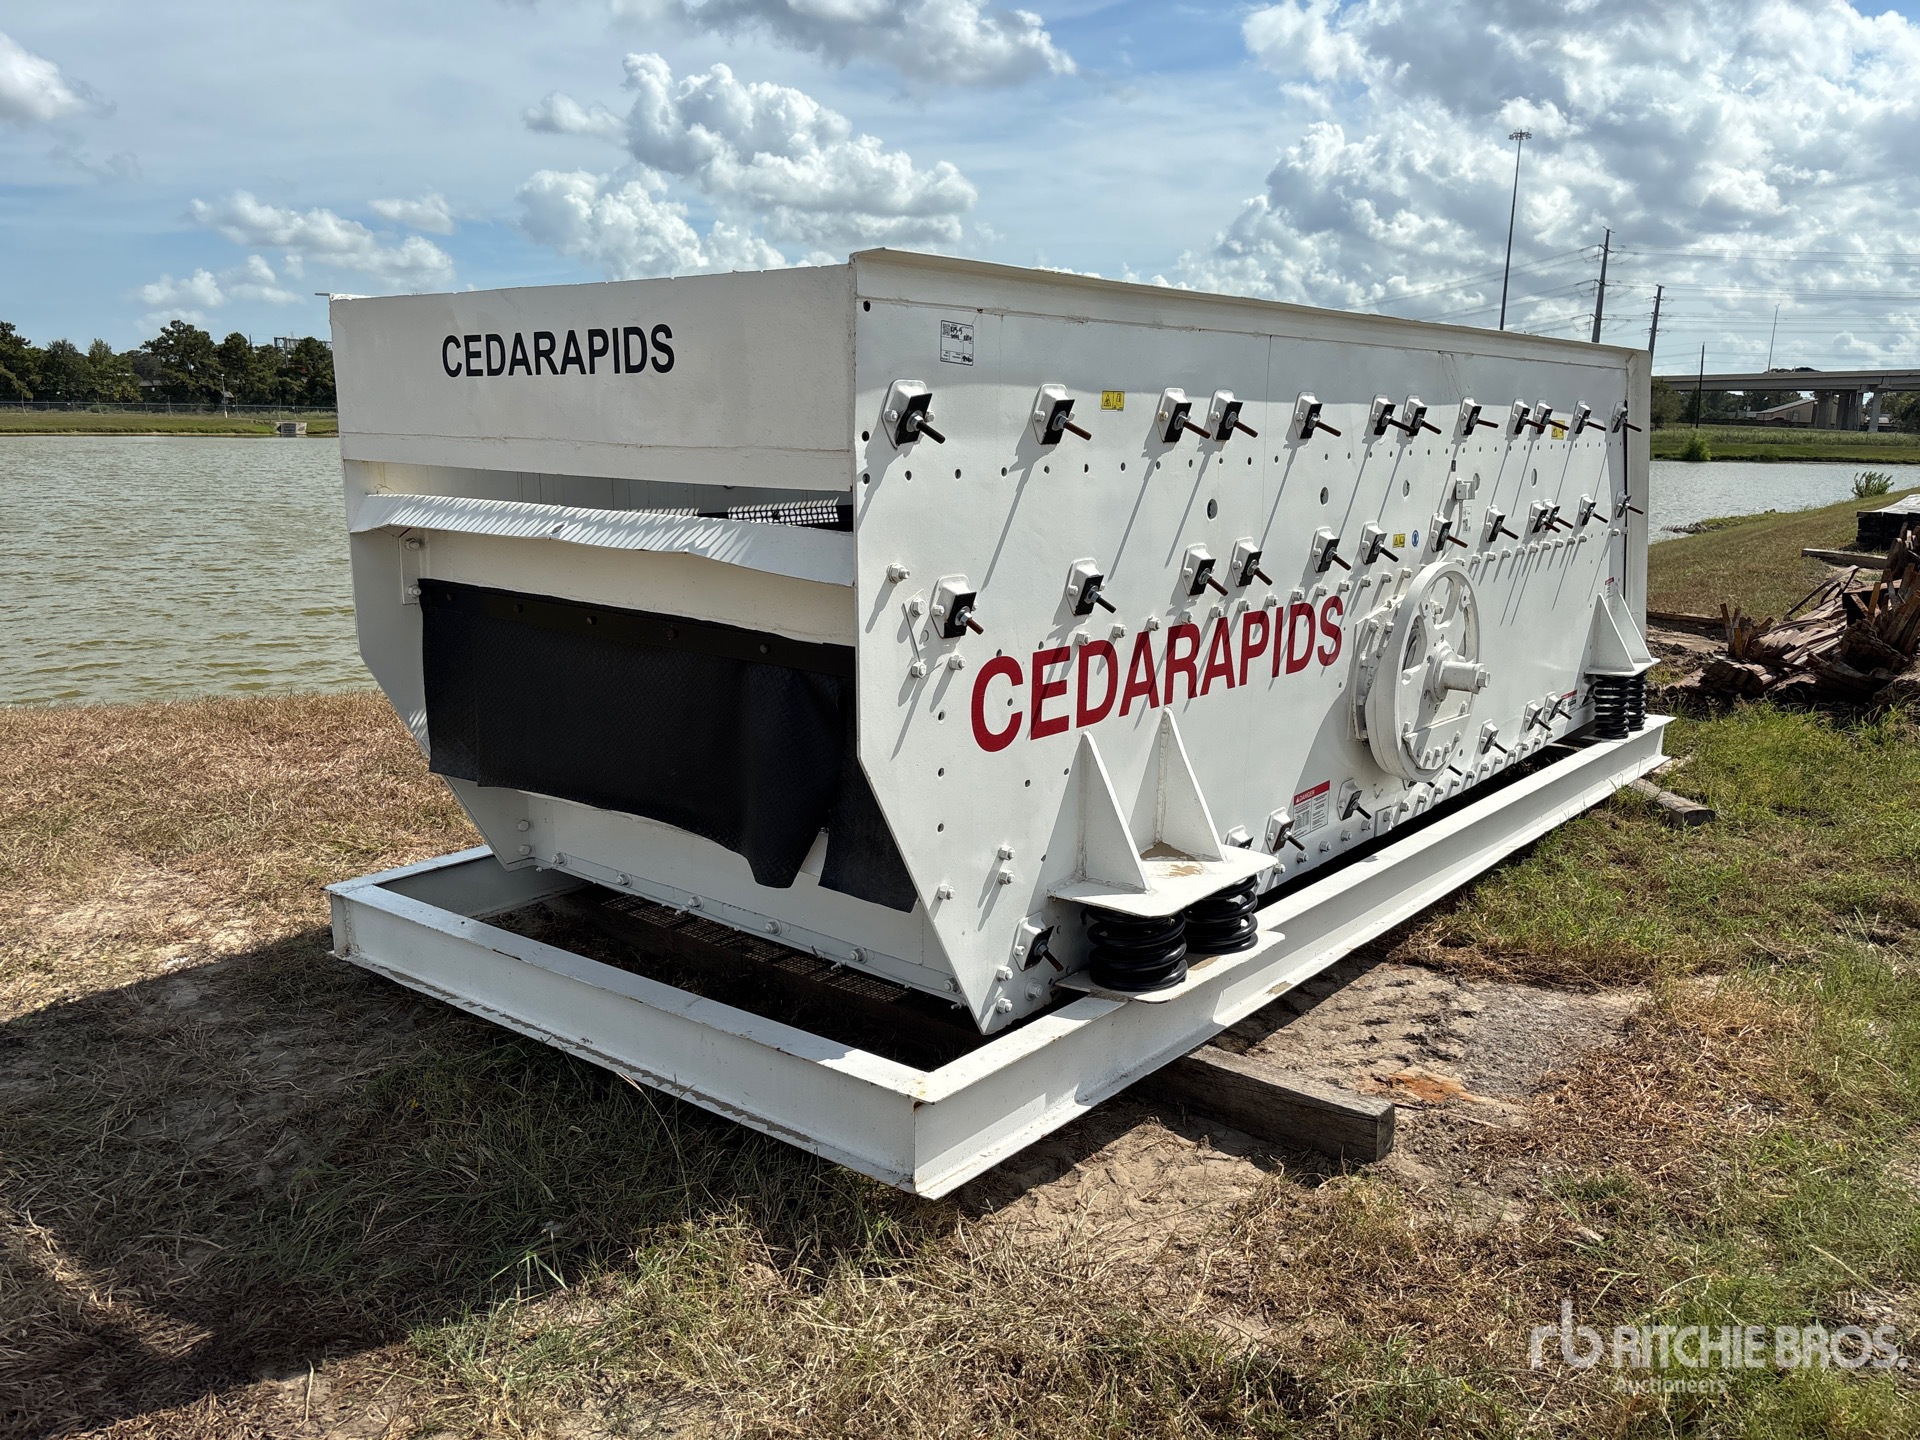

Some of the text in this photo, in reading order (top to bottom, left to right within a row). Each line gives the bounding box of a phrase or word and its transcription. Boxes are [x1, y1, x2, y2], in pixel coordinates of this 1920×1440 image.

[442, 323, 675, 378] CEDARAPIDS
[971, 595, 1344, 752] CEDARAPIDS
[1299, 789, 1316, 801] DANGER
